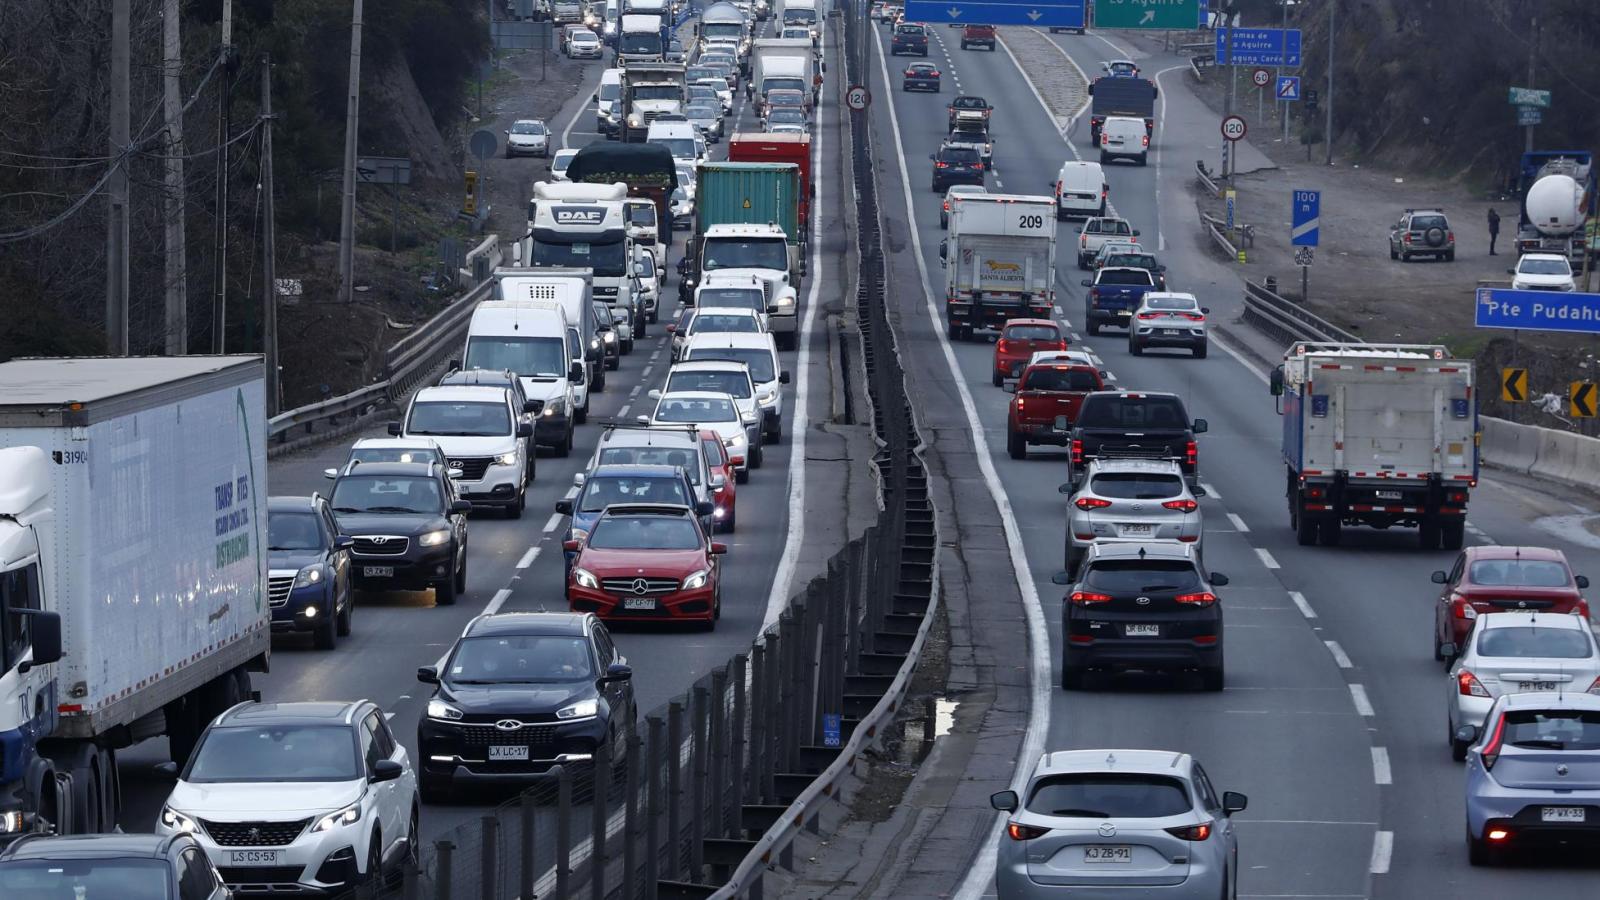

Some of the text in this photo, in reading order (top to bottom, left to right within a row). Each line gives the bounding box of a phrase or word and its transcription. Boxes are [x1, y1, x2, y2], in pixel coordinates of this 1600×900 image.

[1241, 41, 1272, 49] Aguirre
[1232, 55, 1257, 63] aguna
[1255, 73, 1268, 82] 60
[1225, 123, 1243, 134] 120
[1296, 191, 1316, 202] 100
[1302, 204, 1310, 212] m
[557, 211, 601, 220] DAF
[1018, 215, 1043, 229] 209
[1487, 301, 1521, 316] Pte
[215, 473, 249, 512] TRANSPRTES
